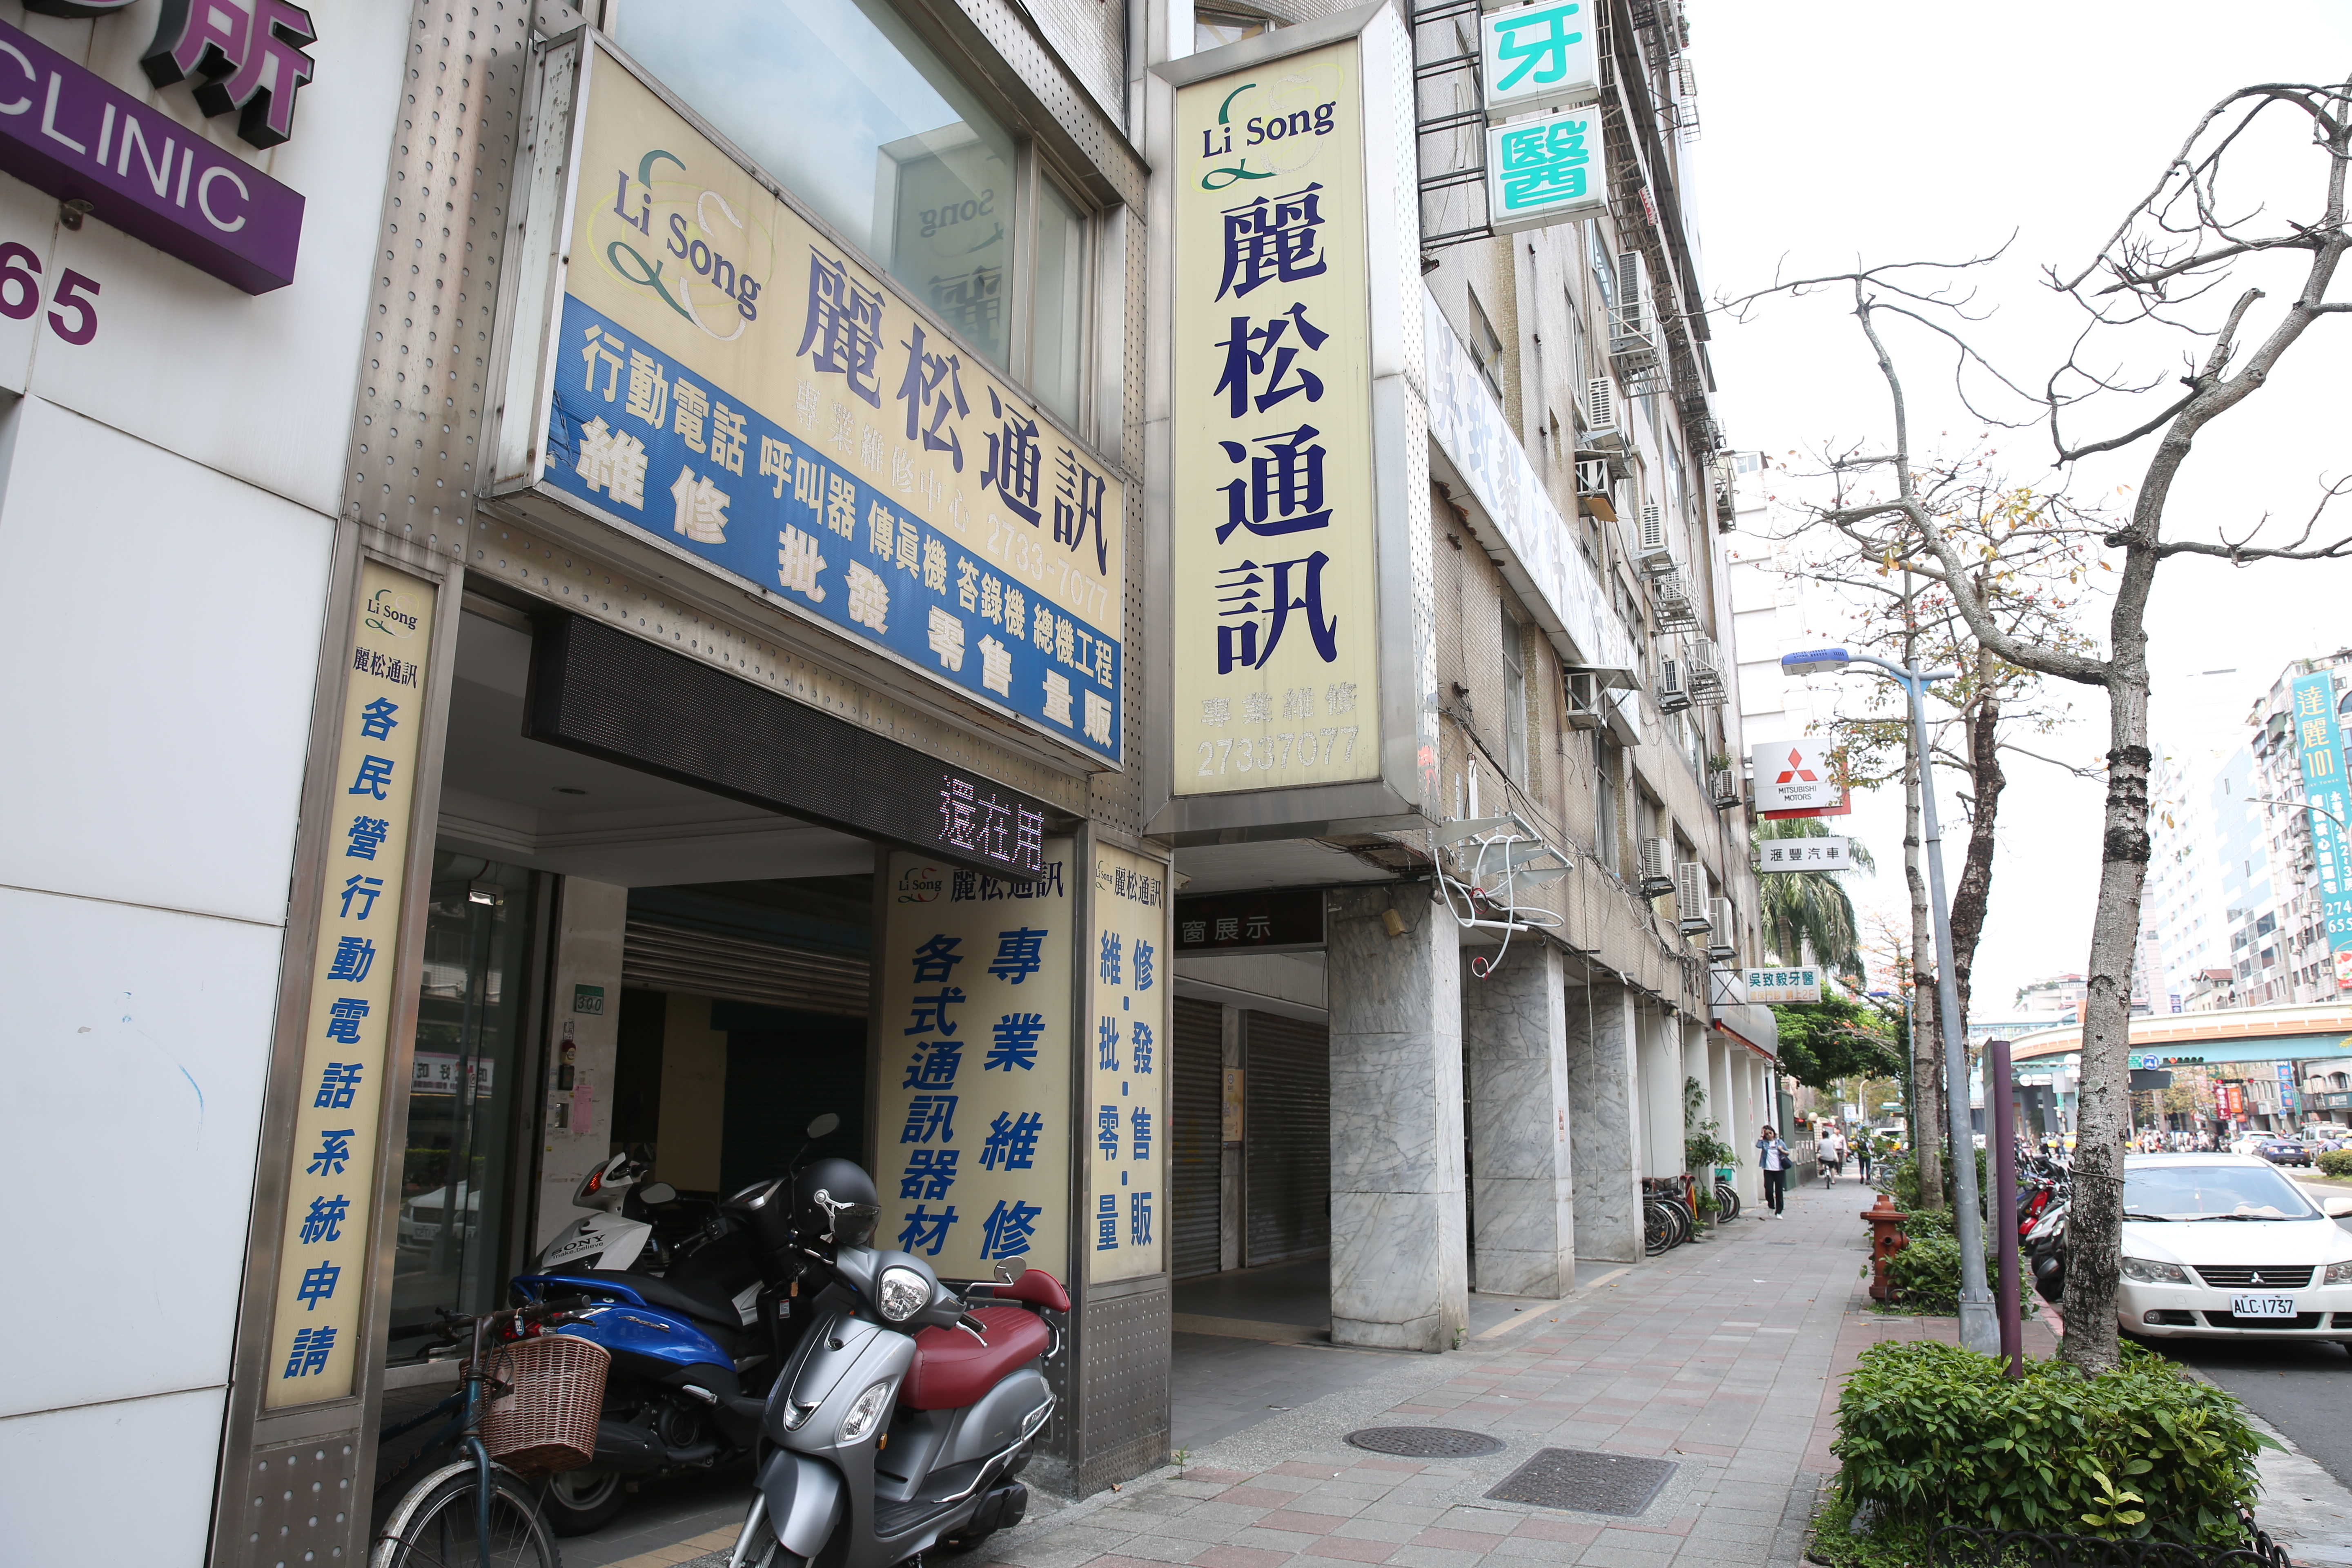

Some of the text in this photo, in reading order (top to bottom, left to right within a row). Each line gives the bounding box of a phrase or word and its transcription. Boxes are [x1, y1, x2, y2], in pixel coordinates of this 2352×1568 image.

[1203, 101, 1336, 158] Li Song
[1494, 3, 1589, 209] 牙醫
[0, 39, 249, 233] CLINIC
[614, 170, 762, 321] Li Song
[796, 243, 1107, 576] 麗松通訊
[1214, 181, 1337, 675] 麗松通訊
[582, 324, 747, 477] 行動電話
[759, 435, 856, 541] 呼叫器
[957, 556, 1025, 641] 答錄機
[1033, 602, 1113, 690] 總機工程
[794, 377, 1108, 621] 專業維修中心 2733-7077
[575, 415, 1113, 749] 維修 批發 零售 量販
[367, 599, 418, 630] Li Song
[352, 646, 418, 689] 麗松通訊
[1201, 682, 1357, 728] 專業維修
[1198, 724, 1359, 776] 27337077
[1778, 785, 1817, 794] MITSUBISHI
[899, 879, 943, 894] Li Song
[1114, 866, 1162, 910] 麗松通訊
[1182, 916, 1271, 942] 窗展示
[577, 996, 602, 1011] 300
[1749, 971, 1813, 987] 吳致毅牙醫
[283, 697, 399, 1379] 各民營行動電話系統申請
[898, 934, 967, 1256] 各式通訊器材
[979, 927, 1048, 1261] 專業維修
[551, 1234, 606, 1256] SONY
[553, 1242, 604, 1259] make.believe
[2234, 1299, 2293, 1314] ALC-1737
